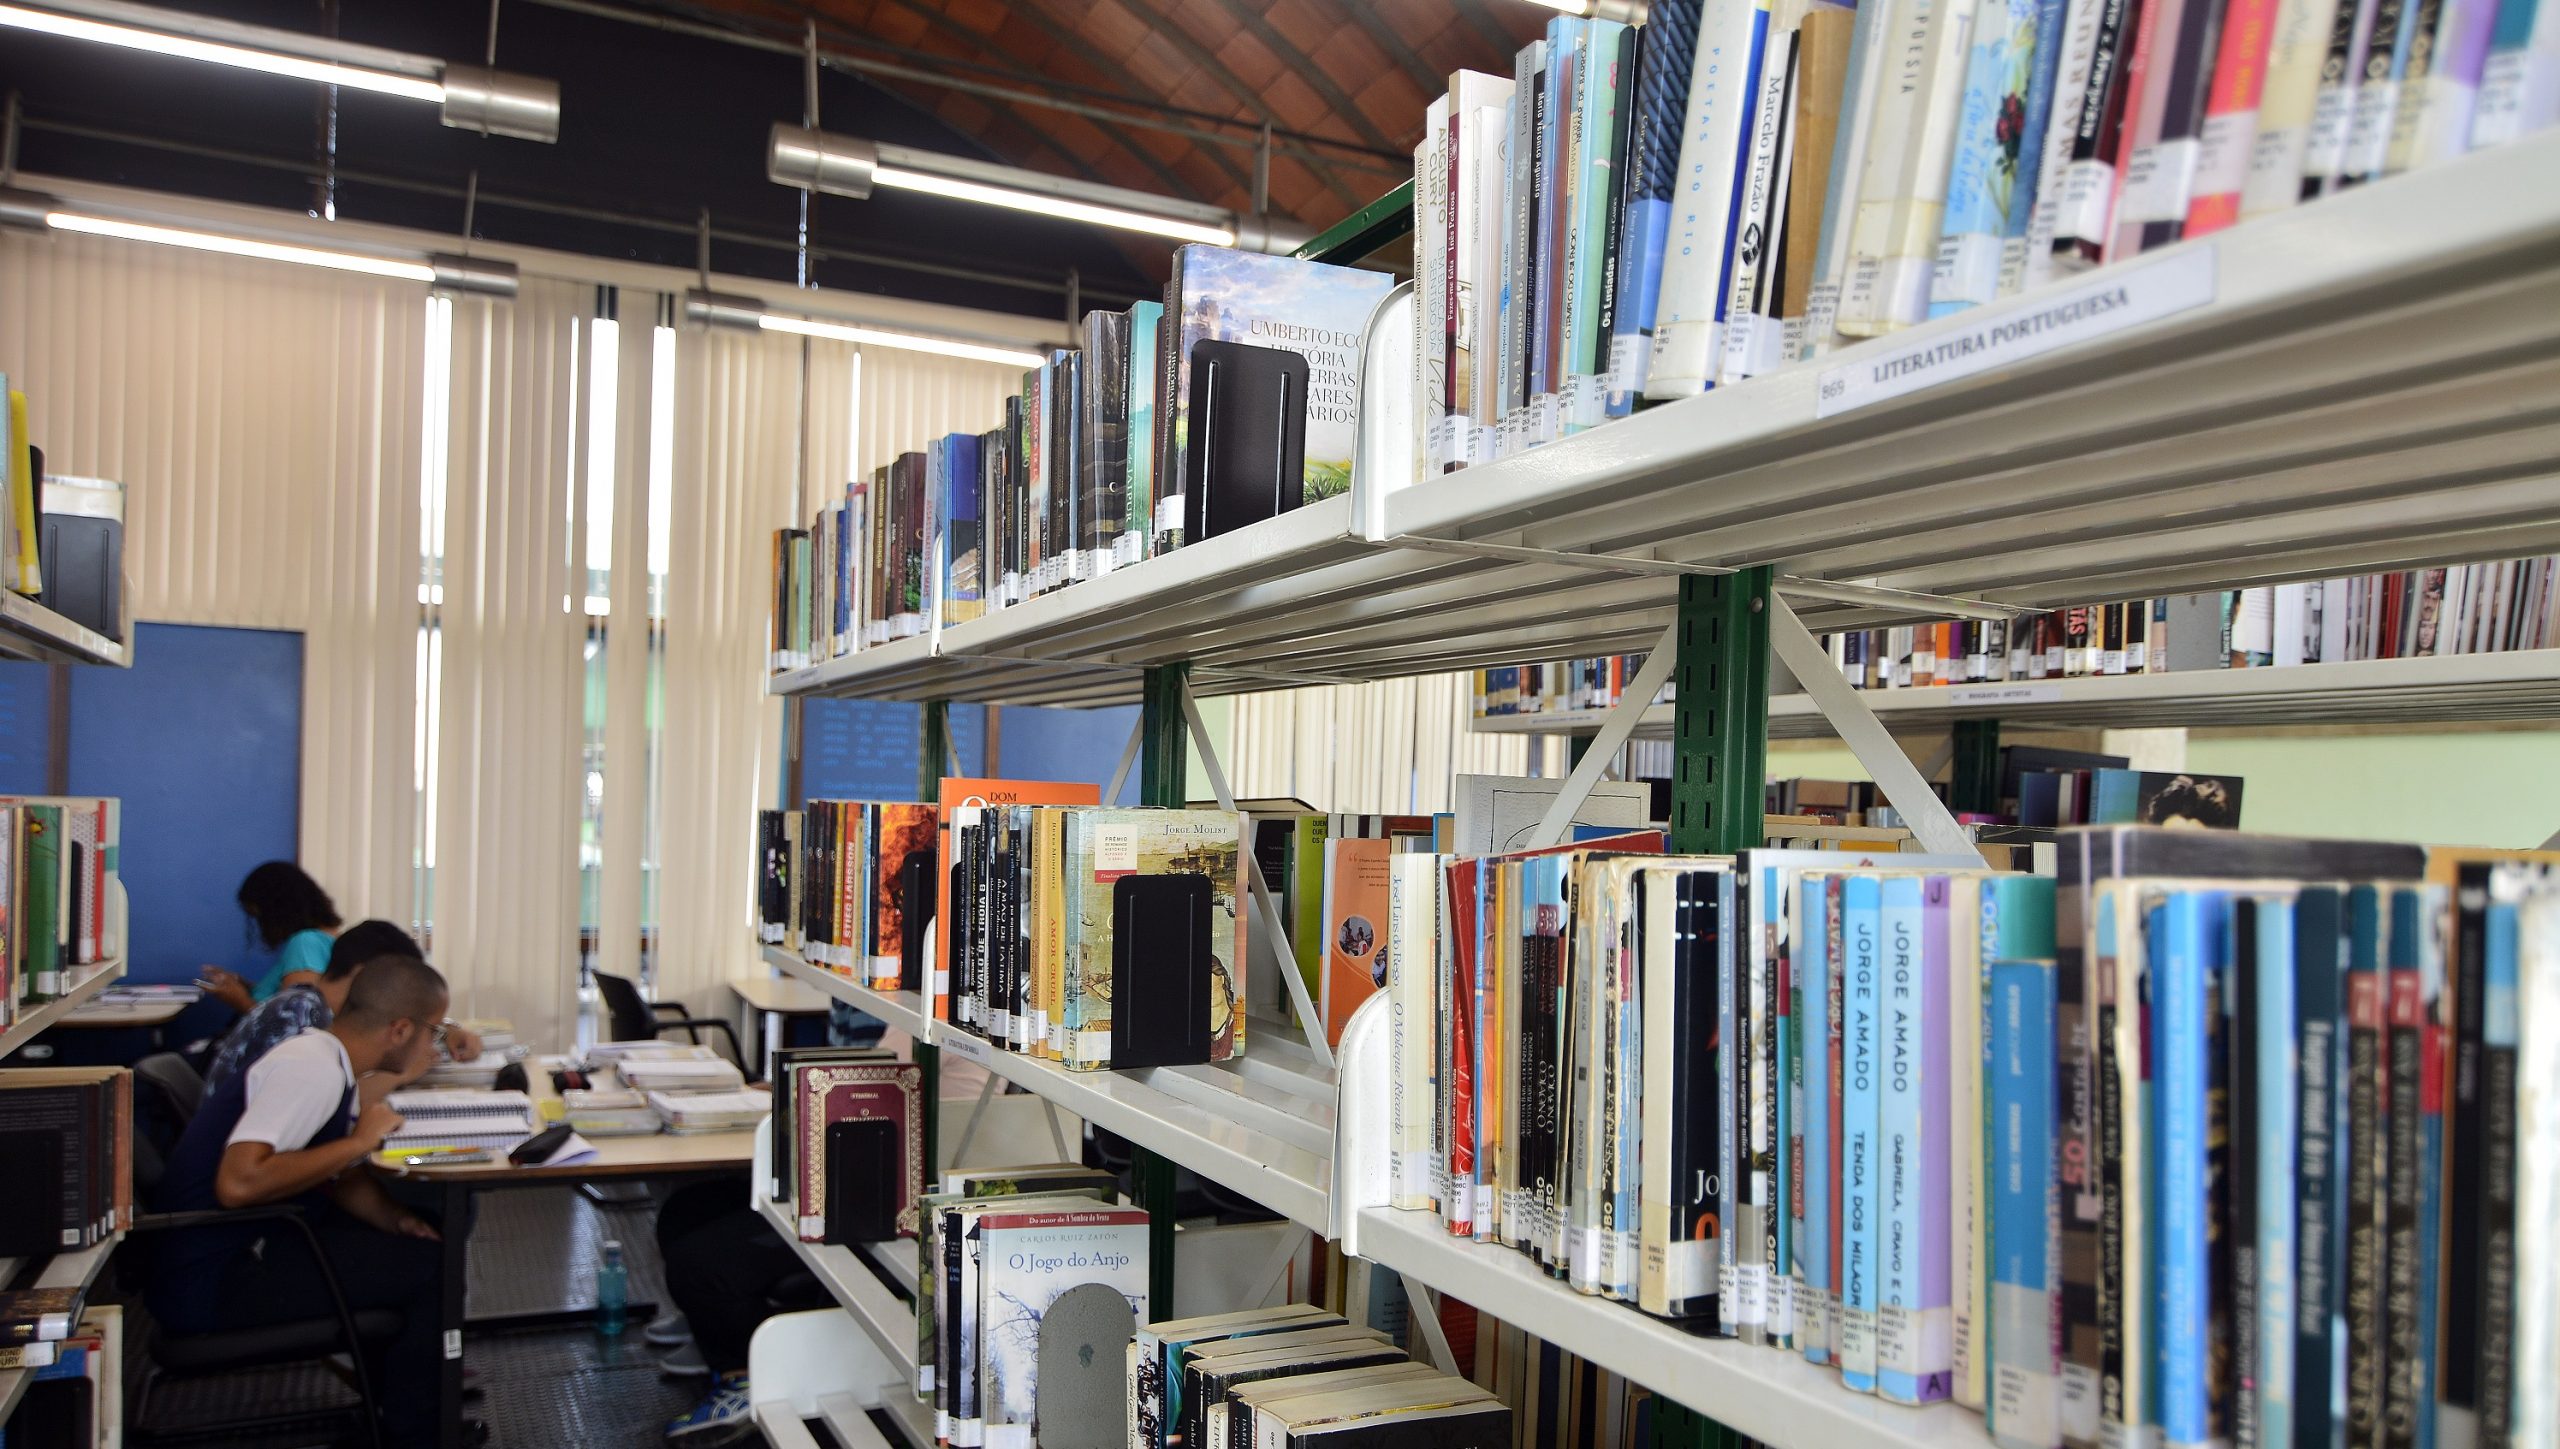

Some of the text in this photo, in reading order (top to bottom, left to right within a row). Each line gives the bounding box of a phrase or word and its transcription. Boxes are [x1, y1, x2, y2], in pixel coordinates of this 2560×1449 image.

[1682, 47, 1720, 256] POETAS DO RIO
[1751, 76, 1783, 213] Marcelo Frazão
[1429, 152, 1438, 208] CURY
[1437, 127, 1447, 224] AUGUSTO
[1517, 196, 1526, 277] Caminho
[1429, 259, 1438, 326] SENTIDO
[1436, 246, 1446, 354] EM BUSCA DO
[1602, 256, 1615, 328] Os Lusíadas
[1250, 320, 1331, 345] UMBERTO
[1874, 285, 2131, 384] LITERATURA PORTUGUESA
[1308, 368, 1356, 388] ERRAS
[1310, 387, 1353, 406] ARES
[1821, 379, 1846, 400] 869
[1307, 400, 1356, 425] ÁRIOS
[989, 791, 1017, 802] DOM
[1162, 824, 1227, 836] JORGE MOLIST
[844, 841, 856, 939] STIEG LARSSON
[1930, 882, 1942, 904] J
[1391, 874, 1402, 987] José Lins do Rego
[1855, 923, 1871, 1091] JORGE AMADO
[1893, 922, 1910, 1092] JORGE AMADO
[1393, 1002, 1404, 1135] O Moleque Ricardo
[2064, 1139, 2084, 1184] 50
[1020, 1232, 1120, 1244] CARLOS RUIZ ZAFÓN
[1029, 1217, 1038, 1225] Do
[1070, 1214, 1089, 1223] Sombra
[1089, 1214, 1096, 1222] do
[1096, 1214, 1110, 1222] Vento
[1850, 1131, 1866, 1307] TENDA DOS MILAGR
[1890, 1133, 1905, 1305] GABRIELA, CRAVO E C
[1009, 1250, 1129, 1274] O Jogo do Anjo
[1925, 1373, 1942, 1395] A
[1189, 1417, 1197, 1448] Isabel
[1213, 1414, 1221, 1449] O LIVR
